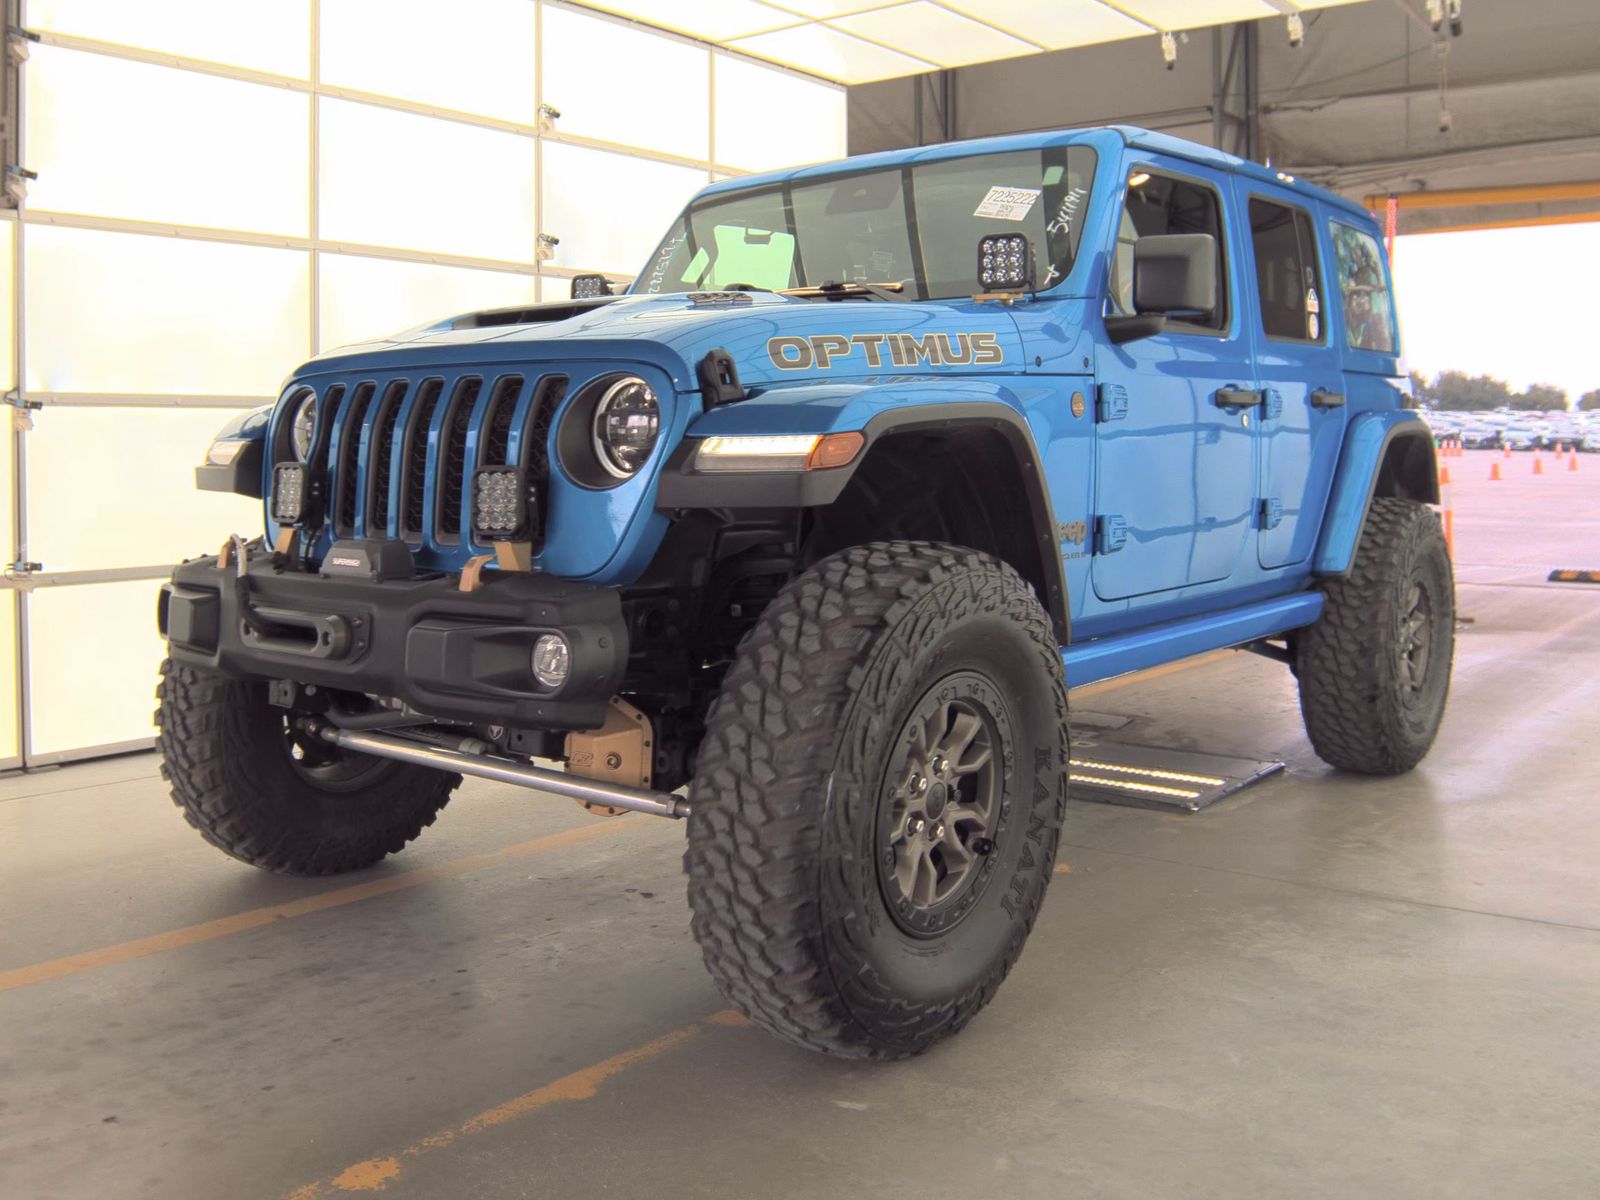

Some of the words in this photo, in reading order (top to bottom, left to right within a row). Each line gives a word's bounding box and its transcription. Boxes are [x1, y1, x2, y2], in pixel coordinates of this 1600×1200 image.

[987, 190, 1039, 205] 7225222
[767, 333, 1003, 370] OPTIMUS
[1057, 521, 1087, 545] eep
[1001, 746, 1052, 920] KANATI
